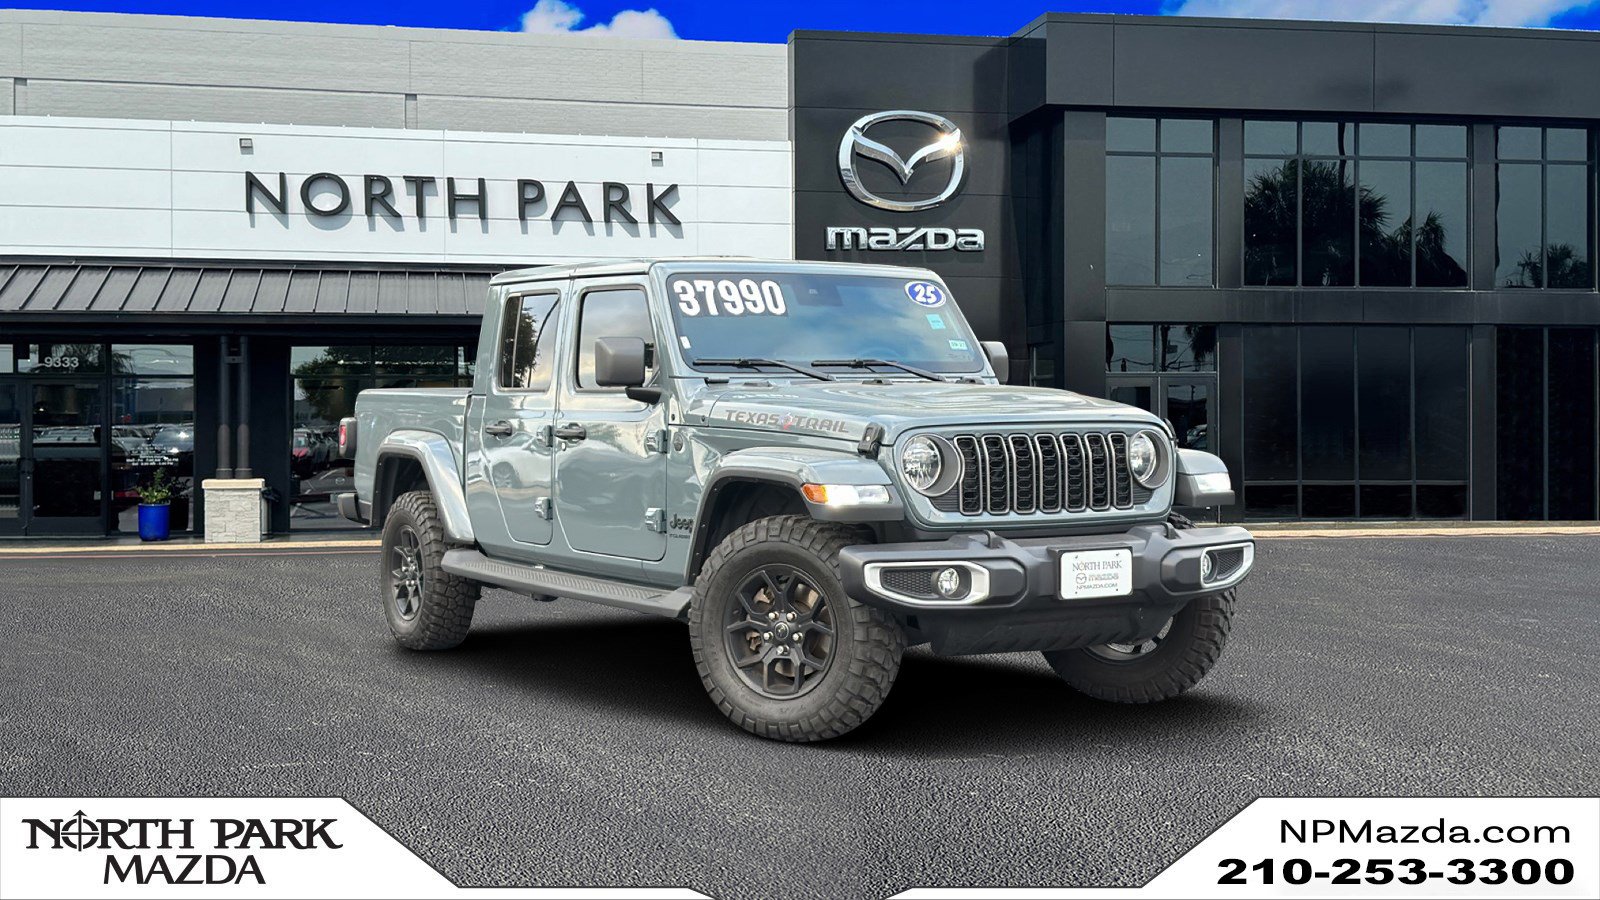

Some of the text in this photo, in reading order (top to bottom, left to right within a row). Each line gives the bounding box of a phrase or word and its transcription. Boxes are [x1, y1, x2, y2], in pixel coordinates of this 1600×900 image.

[245, 171, 682, 225] NORTH PARK
[673, 278, 786, 316] 37990
[913, 284, 937, 303] 25
[44, 356, 79, 368] 9333
[725, 409, 849, 433] TEXAS TRAIL
[1072, 560, 1122, 571] NORTH PARK
